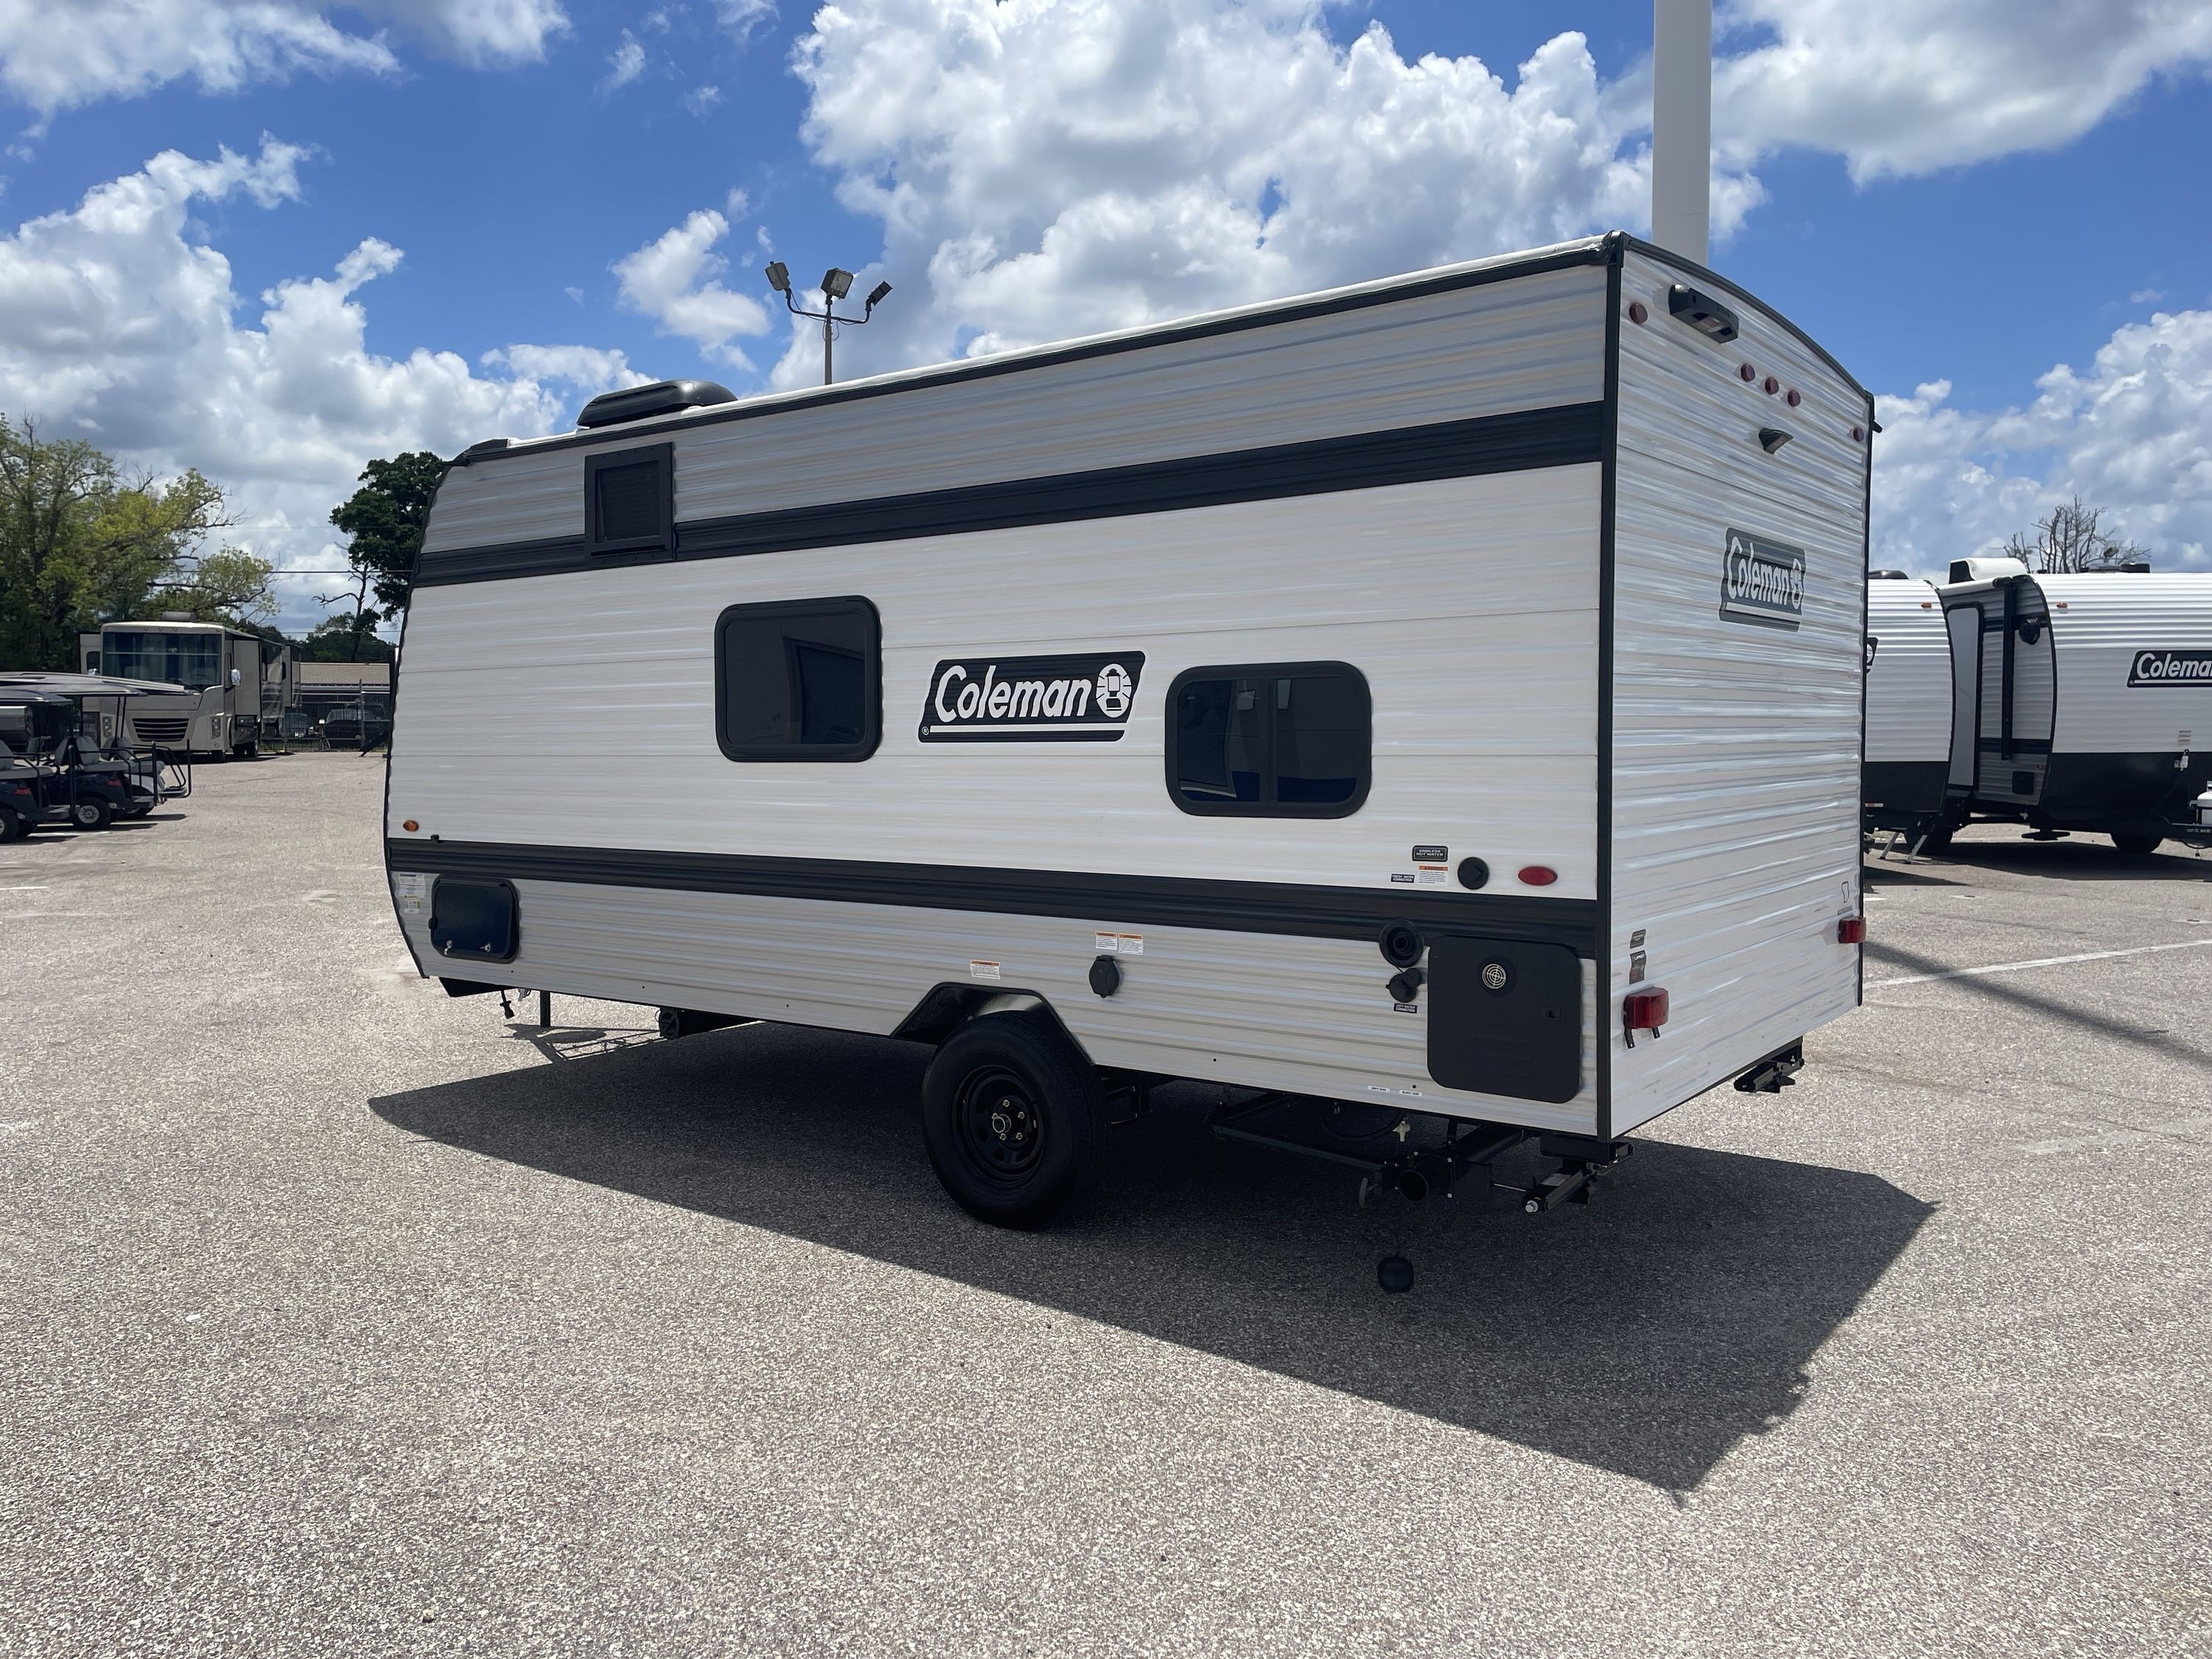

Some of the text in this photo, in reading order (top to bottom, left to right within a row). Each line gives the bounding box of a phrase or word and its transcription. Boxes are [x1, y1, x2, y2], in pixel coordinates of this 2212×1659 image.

[1727, 536, 1790, 605] Coleman
[935, 664, 1092, 723] Coleman
[2137, 653, 2212, 678] Colema
